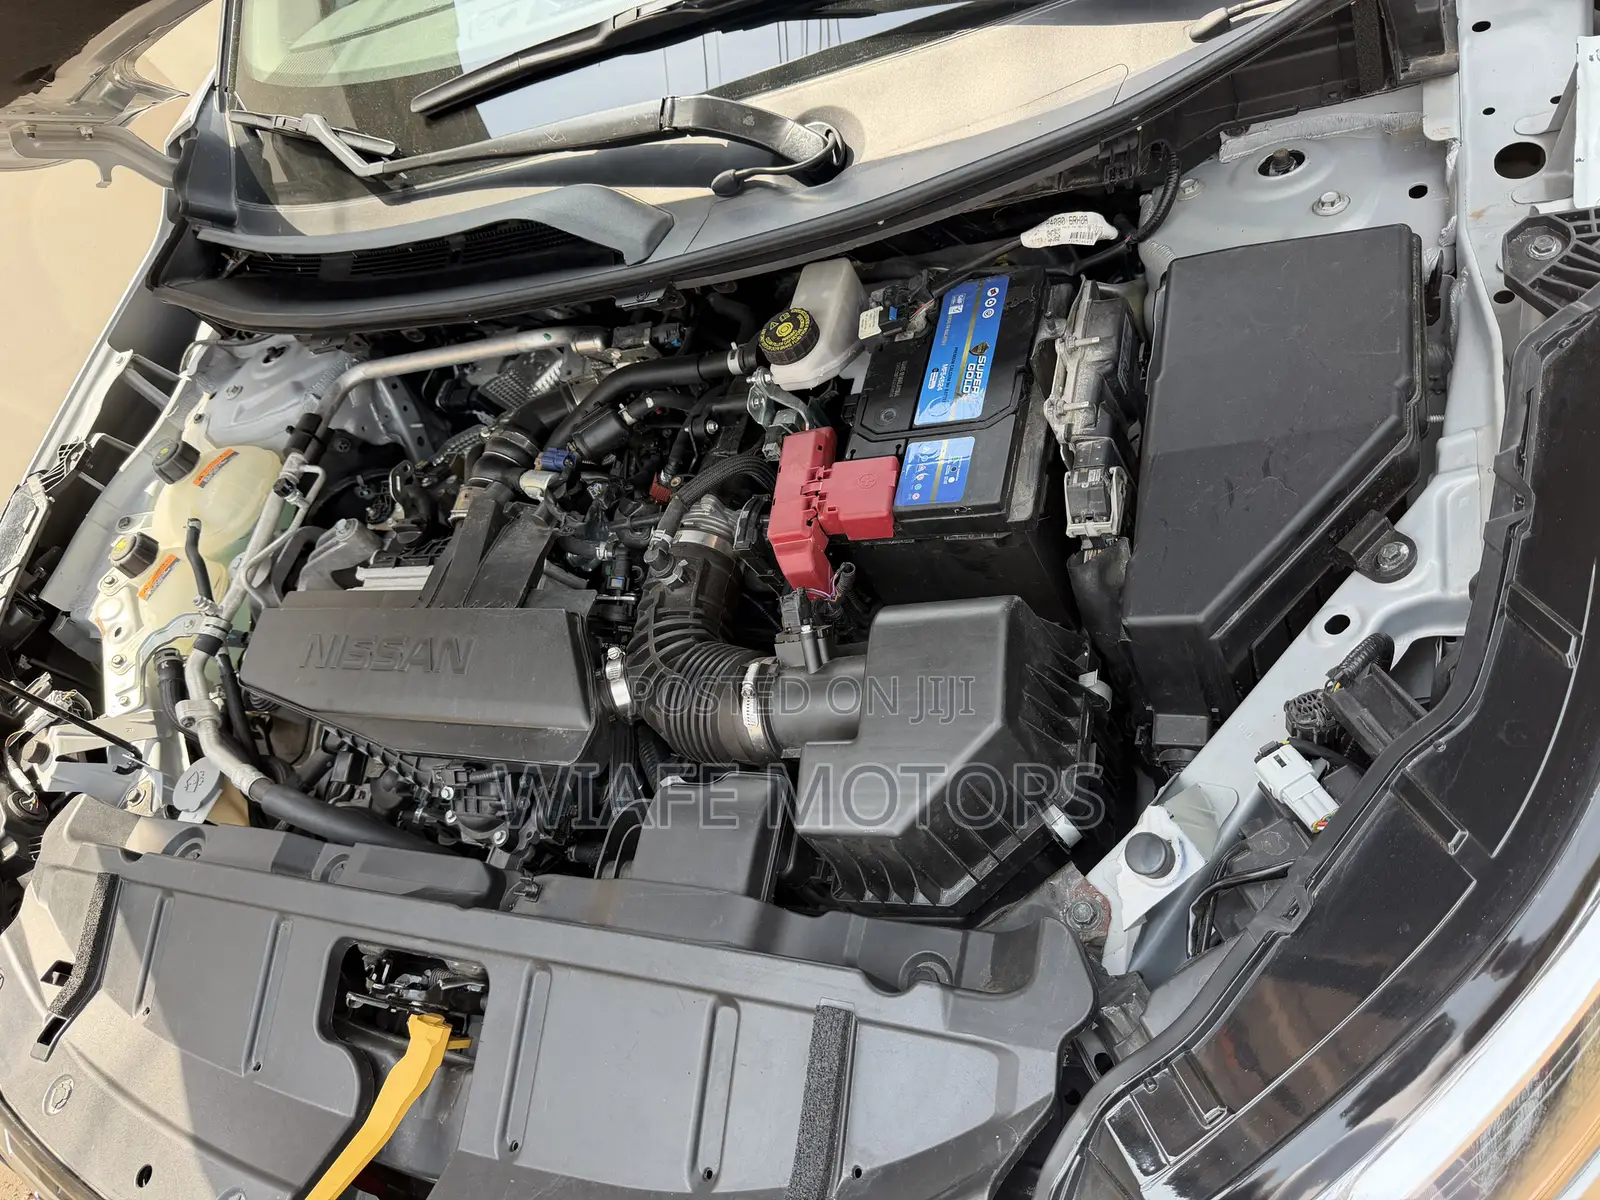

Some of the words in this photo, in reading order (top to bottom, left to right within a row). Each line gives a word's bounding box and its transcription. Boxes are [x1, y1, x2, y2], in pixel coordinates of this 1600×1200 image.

[962, 363, 976, 394] GOLD
[973, 356, 986, 394] SUPER
[299, 633, 476, 675] NISSAN
